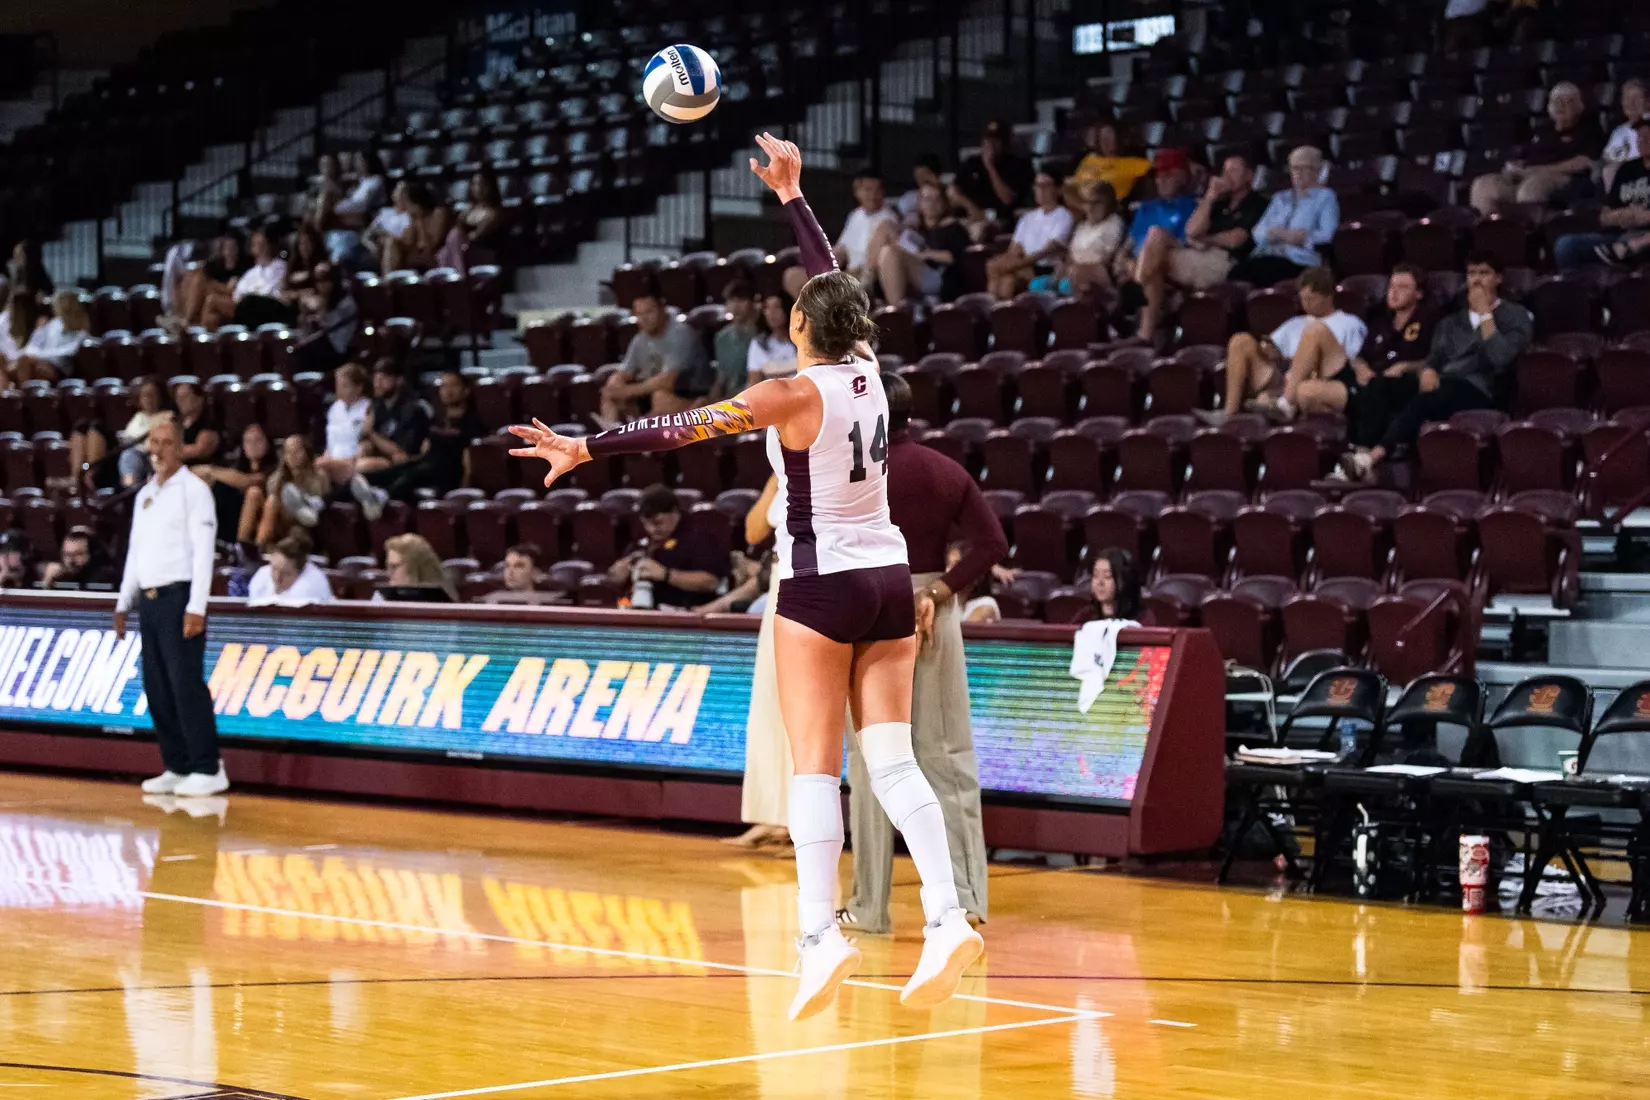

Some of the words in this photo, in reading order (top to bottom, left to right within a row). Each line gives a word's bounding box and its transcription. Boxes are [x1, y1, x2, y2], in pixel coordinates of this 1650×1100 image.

[667, 49, 690, 87] molten
[850, 375, 867, 395] C
[847, 413, 888, 483] 14
[207, 643, 490, 730] MCGUIRK
[482, 656, 711, 744] ARENA
